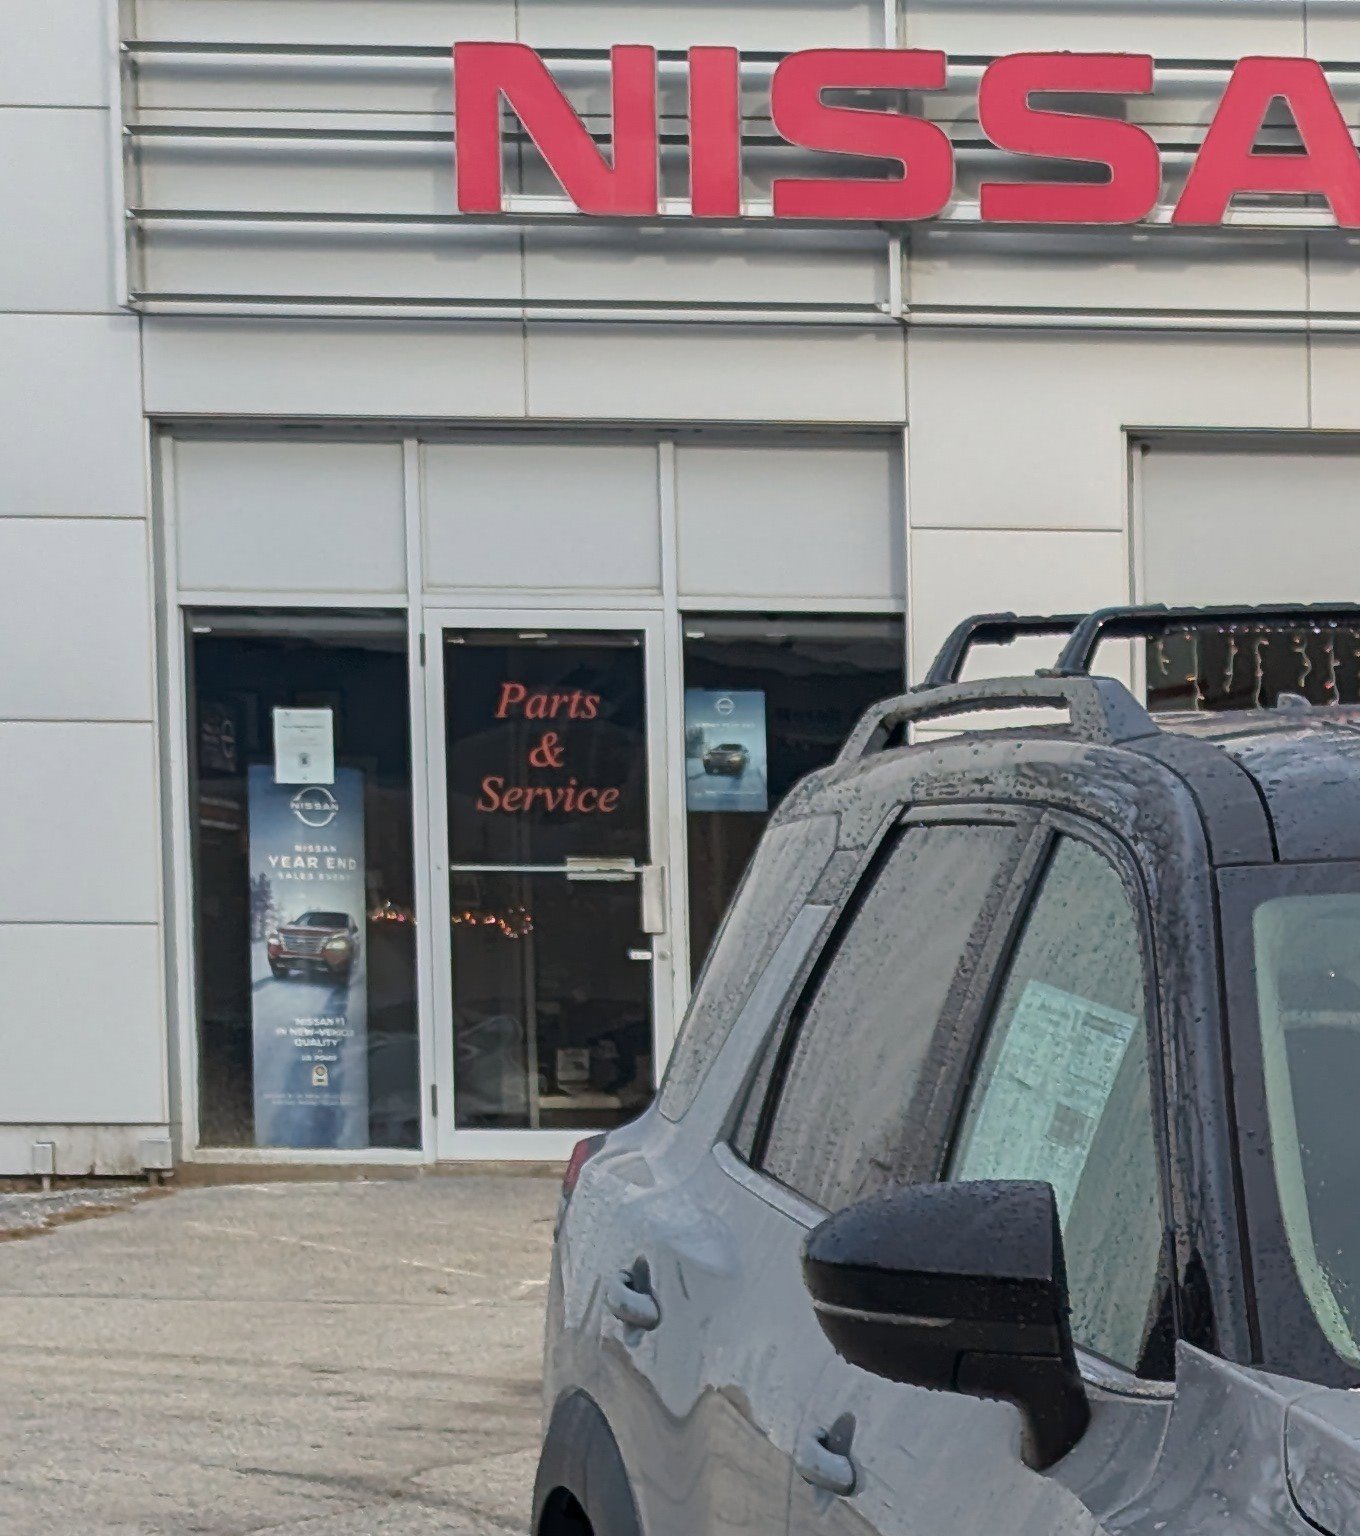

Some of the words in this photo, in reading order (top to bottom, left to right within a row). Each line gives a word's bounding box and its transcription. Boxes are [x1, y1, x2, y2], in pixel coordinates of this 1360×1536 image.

[495, 682, 601, 719] Parts
[529, 731, 565, 768] &
[476, 776, 620, 813] Service
[268, 855, 319, 869] YEAR
[326, 857, 357, 871] END
